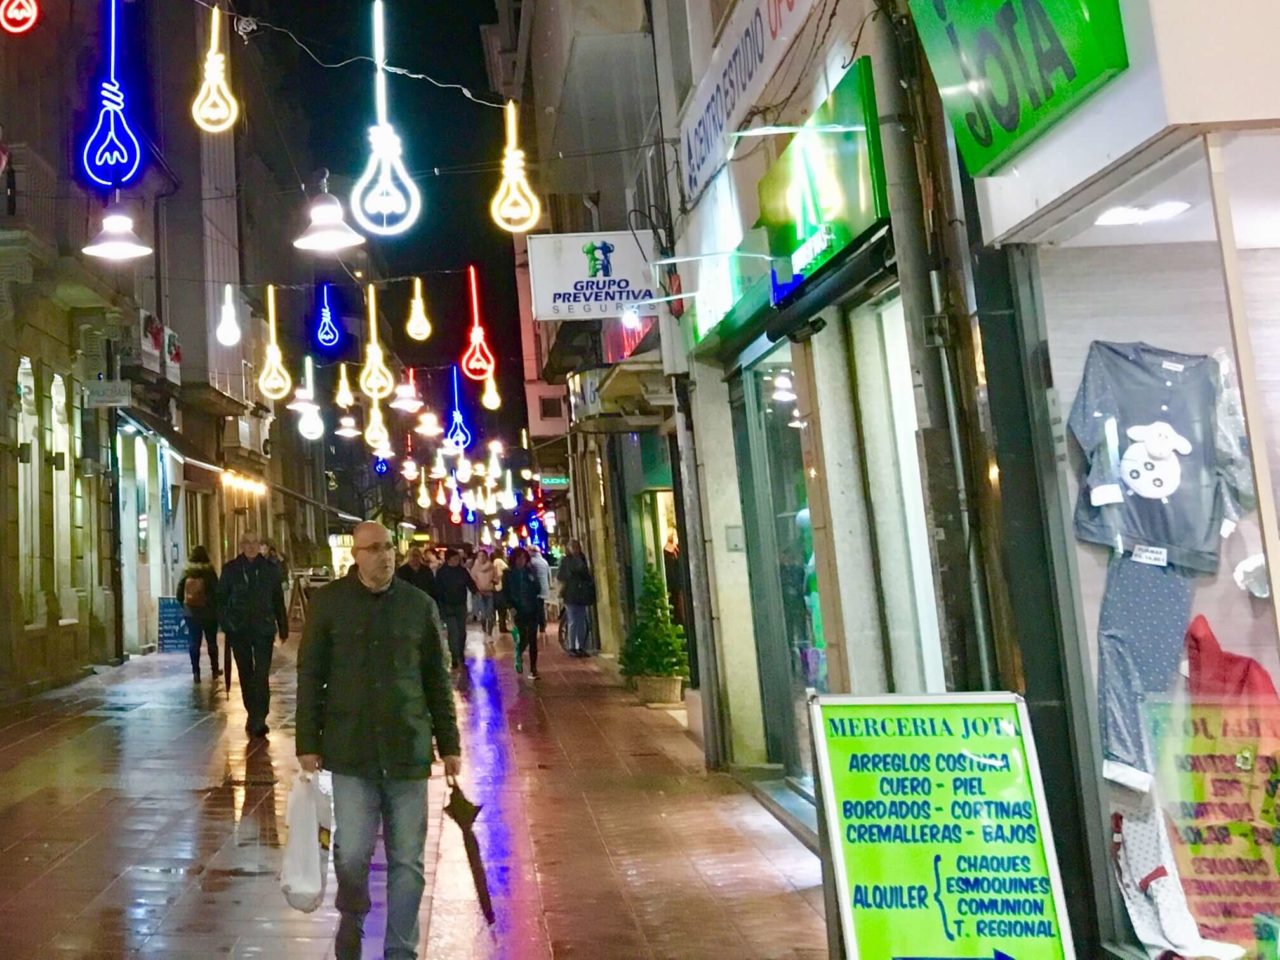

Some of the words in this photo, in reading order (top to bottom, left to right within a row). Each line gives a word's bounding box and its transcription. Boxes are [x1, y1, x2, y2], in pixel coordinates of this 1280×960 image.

[721, 6, 765, 121] ESTUDIO
[573, 279, 630, 292] GRUPO
[552, 289, 654, 304] PREVENTIVA
[829, 717, 955, 738] MERCERIA
[849, 753, 931, 773] ARREGLOS
[936, 753, 1011, 772] COSTURA
[880, 777, 932, 796] CUERO
[952, 777, 986, 796] PIEL
[843, 801, 931, 820] BORDADOS
[951, 801, 1033, 820] CORTINAS
[846, 824, 962, 844] CREMALLERAS
[982, 824, 1037, 844] BAJOS
[956, 855, 1031, 873] CHAQUES
[946, 877, 1051, 895] ESMOQUINES
[852, 885, 929, 910] ALQUILER
[957, 898, 1045, 917] COMUNION
[953, 920, 970, 939] T.
[975, 919, 1057, 938] REGIONAL
